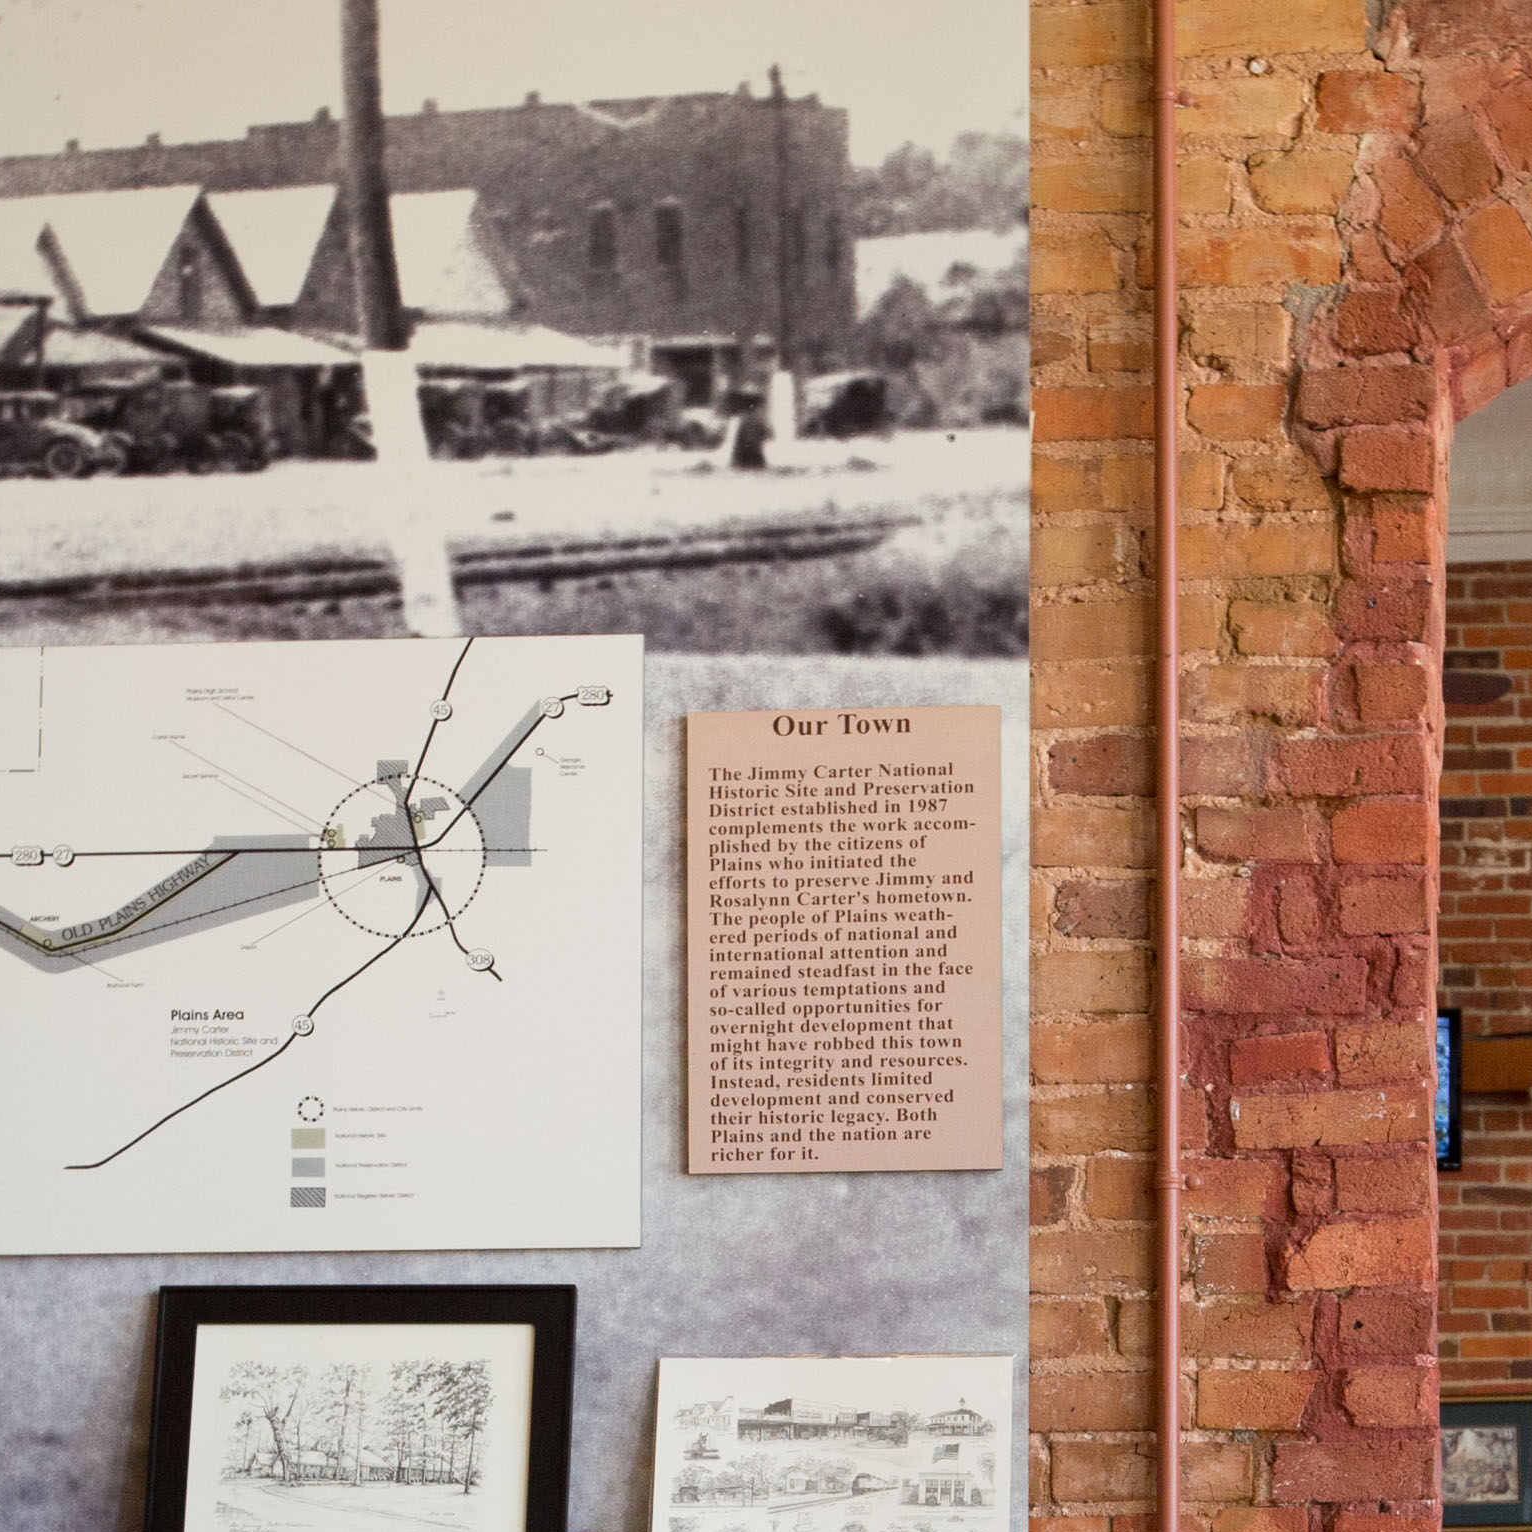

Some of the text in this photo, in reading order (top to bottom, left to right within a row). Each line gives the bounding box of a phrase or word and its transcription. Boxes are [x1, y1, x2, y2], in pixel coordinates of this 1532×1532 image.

[581, 688, 605, 700] 280
[432, 704, 449, 716] 45
[544, 701, 561, 713] 27
[772, 713, 911, 736] Our Town
[708, 762, 953, 783] The Jimmy Carter National
[709, 780, 974, 800] Historic Site and Preservation
[709, 798, 948, 818] District established in 1987
[709, 817, 976, 839] complements the work accom-
[15, 849, 37, 861] 280
[55, 849, 70, 861] 27
[709, 834, 928, 858] plished by the citizens of
[709, 854, 917, 872] Plains who initiated the
[709, 870, 973, 892] efforts to preserve Jimmy and
[61, 854, 213, 941] OLD PLAINS HIGHWAY
[710, 887, 972, 911] Rosalynn Carter's hometown.
[709, 907, 953, 929] The people of Plains weath-
[709, 925, 957, 946] ered periods of national and
[468, 953, 491, 966] 308
[709, 943, 947, 962] international attention and
[710, 961, 973, 980] remained steadfast in the face
[709, 980, 945, 1000] of various temptations and
[170, 1008, 245, 1021] Plains Area
[709, 998, 943, 1019] so-called opportunities for
[170, 1025, 229, 1035] Jimmy Carter
[294, 1018, 310, 1031] 45
[710, 1016, 953, 1038] overnight development that
[170, 1036, 278, 1046] National Historic Site and
[710, 1034, 962, 1057] might have robbed this town
[170, 1048, 253, 1058] Preservation District
[710, 1054, 968, 1074] of its integrity and resources.
[711, 1071, 933, 1091] Instead, residents limited
[710, 1088, 954, 1110] development and conserved
[711, 1107, 937, 1127] their historic legacy. Both
[711, 1126, 932, 1144] Plains and the nation are
[711, 1146, 819, 1162] richer for it.
